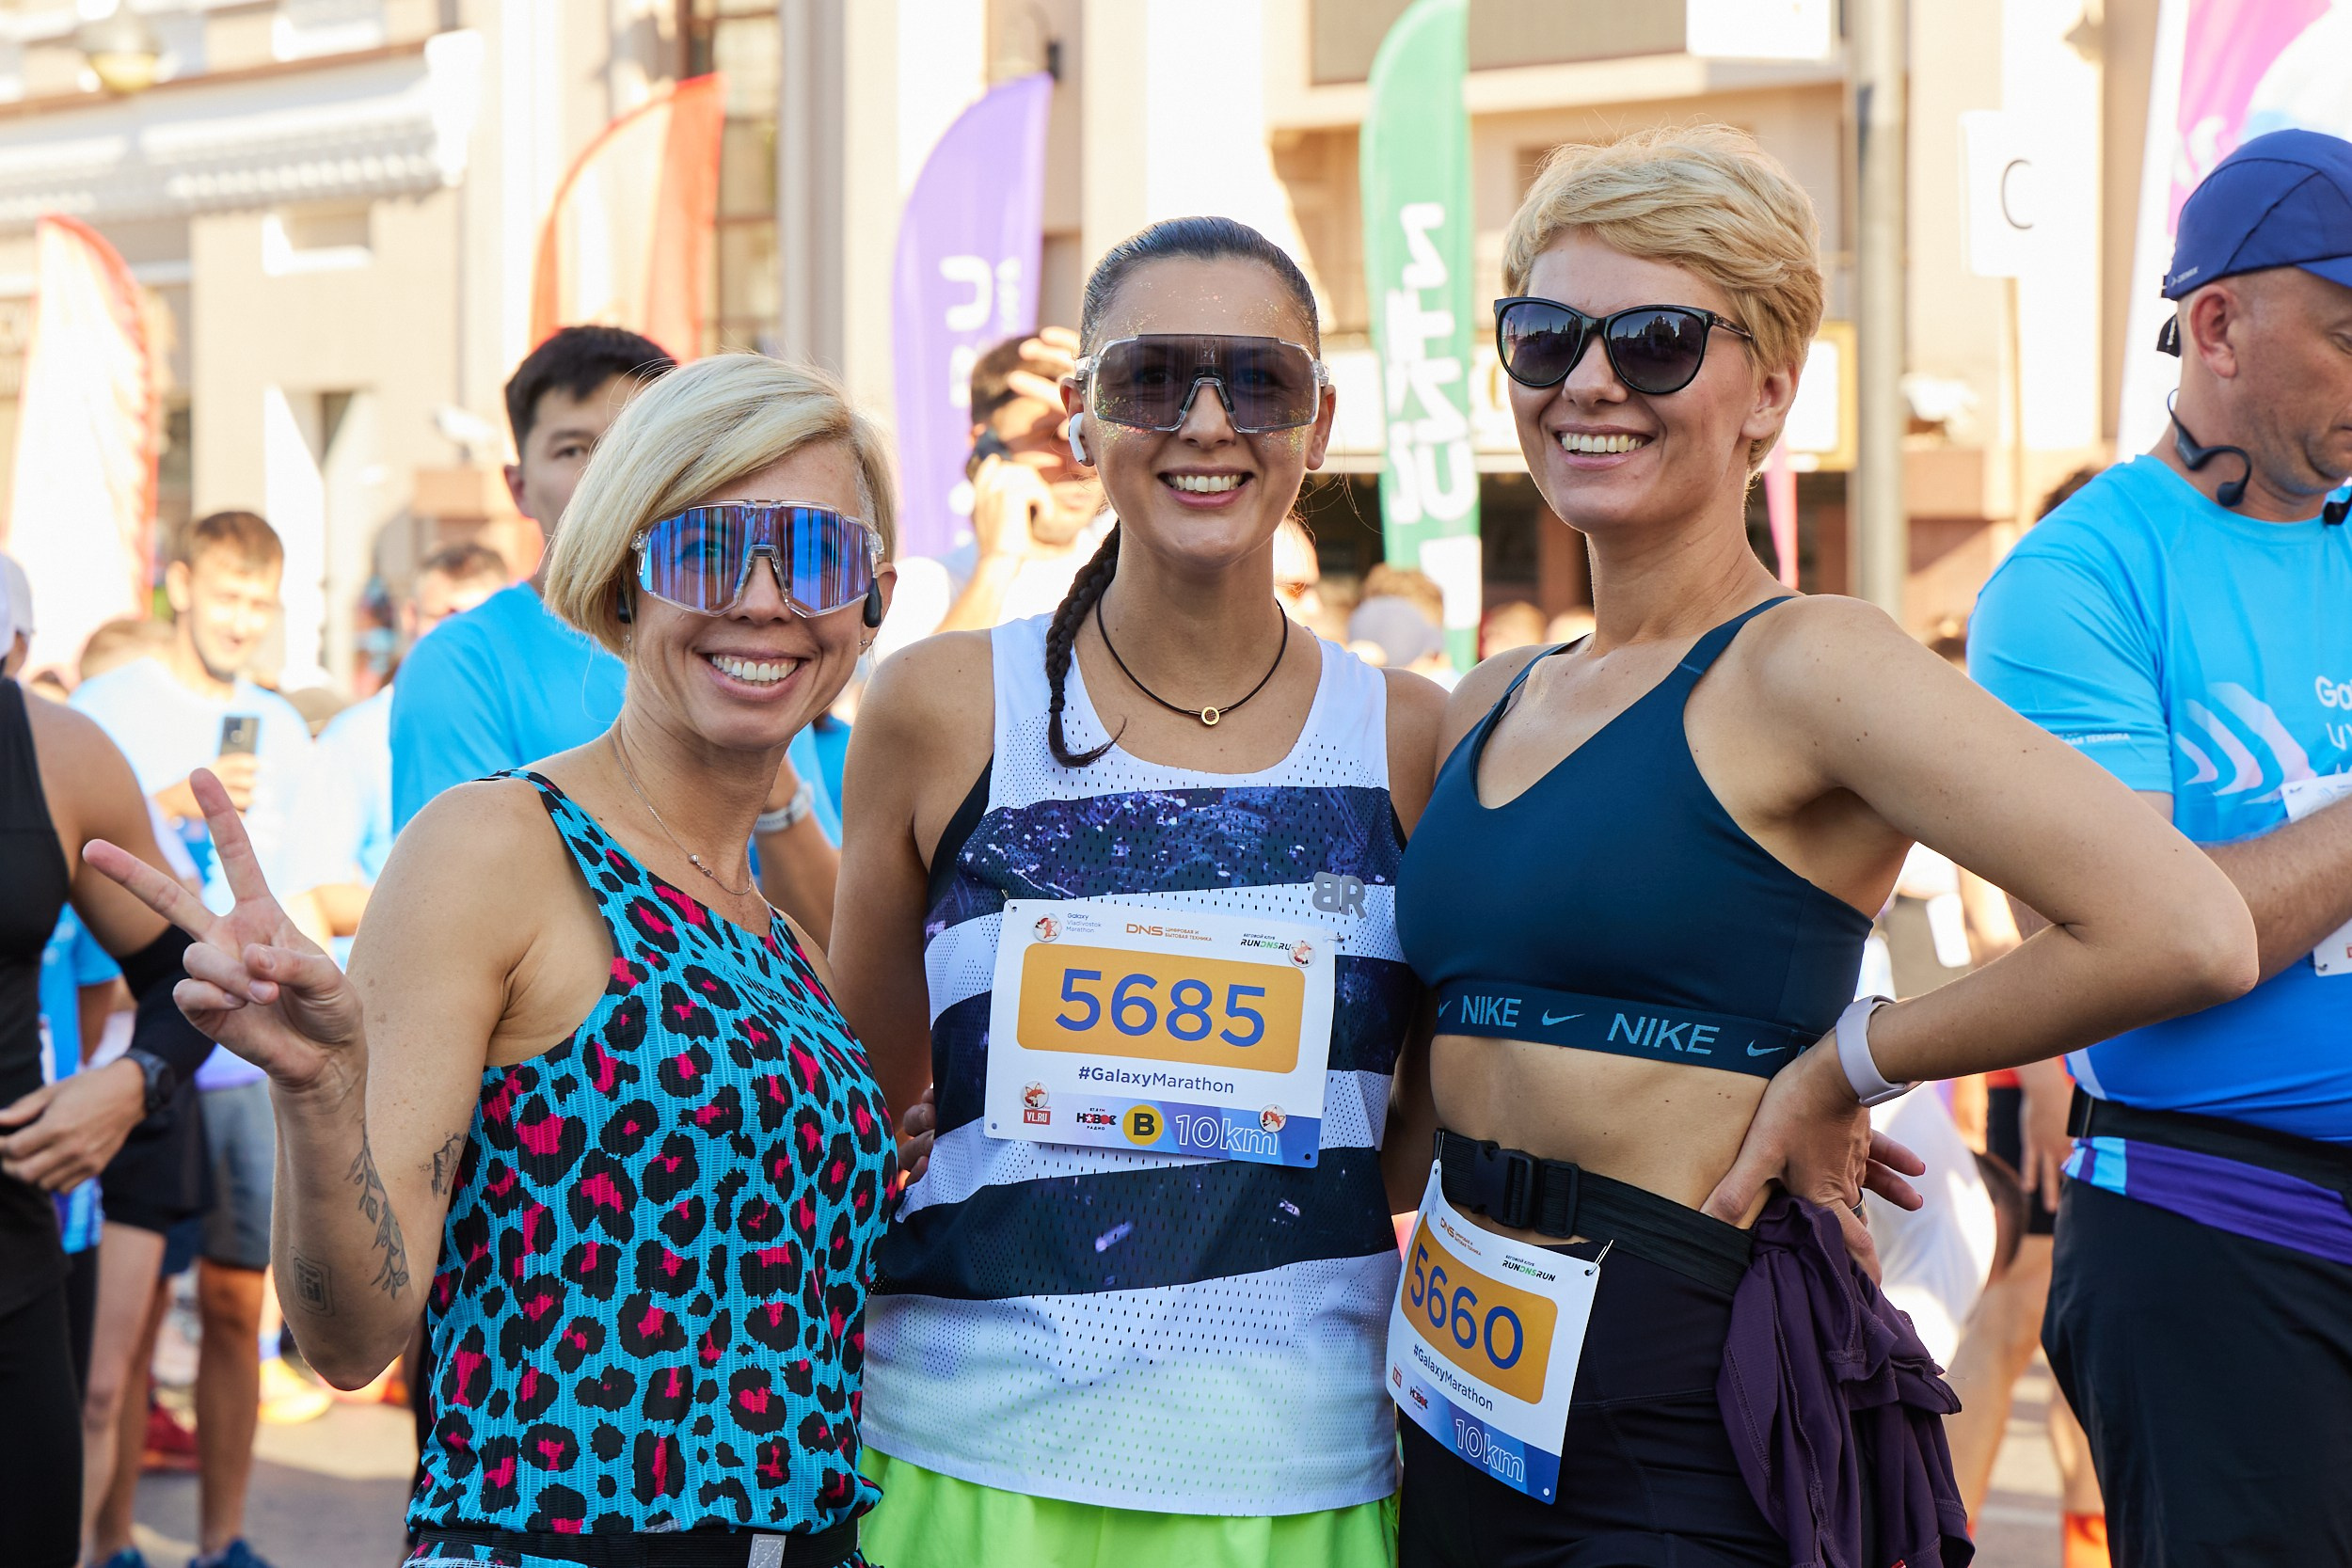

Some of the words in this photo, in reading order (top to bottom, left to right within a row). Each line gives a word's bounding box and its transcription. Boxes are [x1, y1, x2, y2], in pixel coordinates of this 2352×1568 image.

[1067, 912, 1089, 921] Galaxy
[1126, 923, 1163, 937] DNS
[1240, 939, 1291, 950] RUNDNSRU
[736, 970, 792, 1010] UNDER
[787, 997, 810, 1019] BY
[807, 1006, 834, 1030] ME
[1055, 968, 1265, 1048] 5685
[1461, 995, 1522, 1028] NIKE
[1607, 1013, 1720, 1055] NIKE
[1078, 1067, 1234, 1094] #GalaxyMarathon
[1026, 1112, 1048, 1123] VL.RU
[1133, 1113, 1155, 1135] B
[1175, 1114, 1278, 1155] 10km
[1440, 1217, 1454, 1238] DNS
[1502, 1259, 1556, 1281] RUNDNSRUN
[1410, 1242, 1524, 1370] 5660
[1413, 1343, 1493, 1411] #GalaxyMarathon
[1456, 1418, 1524, 1482] 10km
